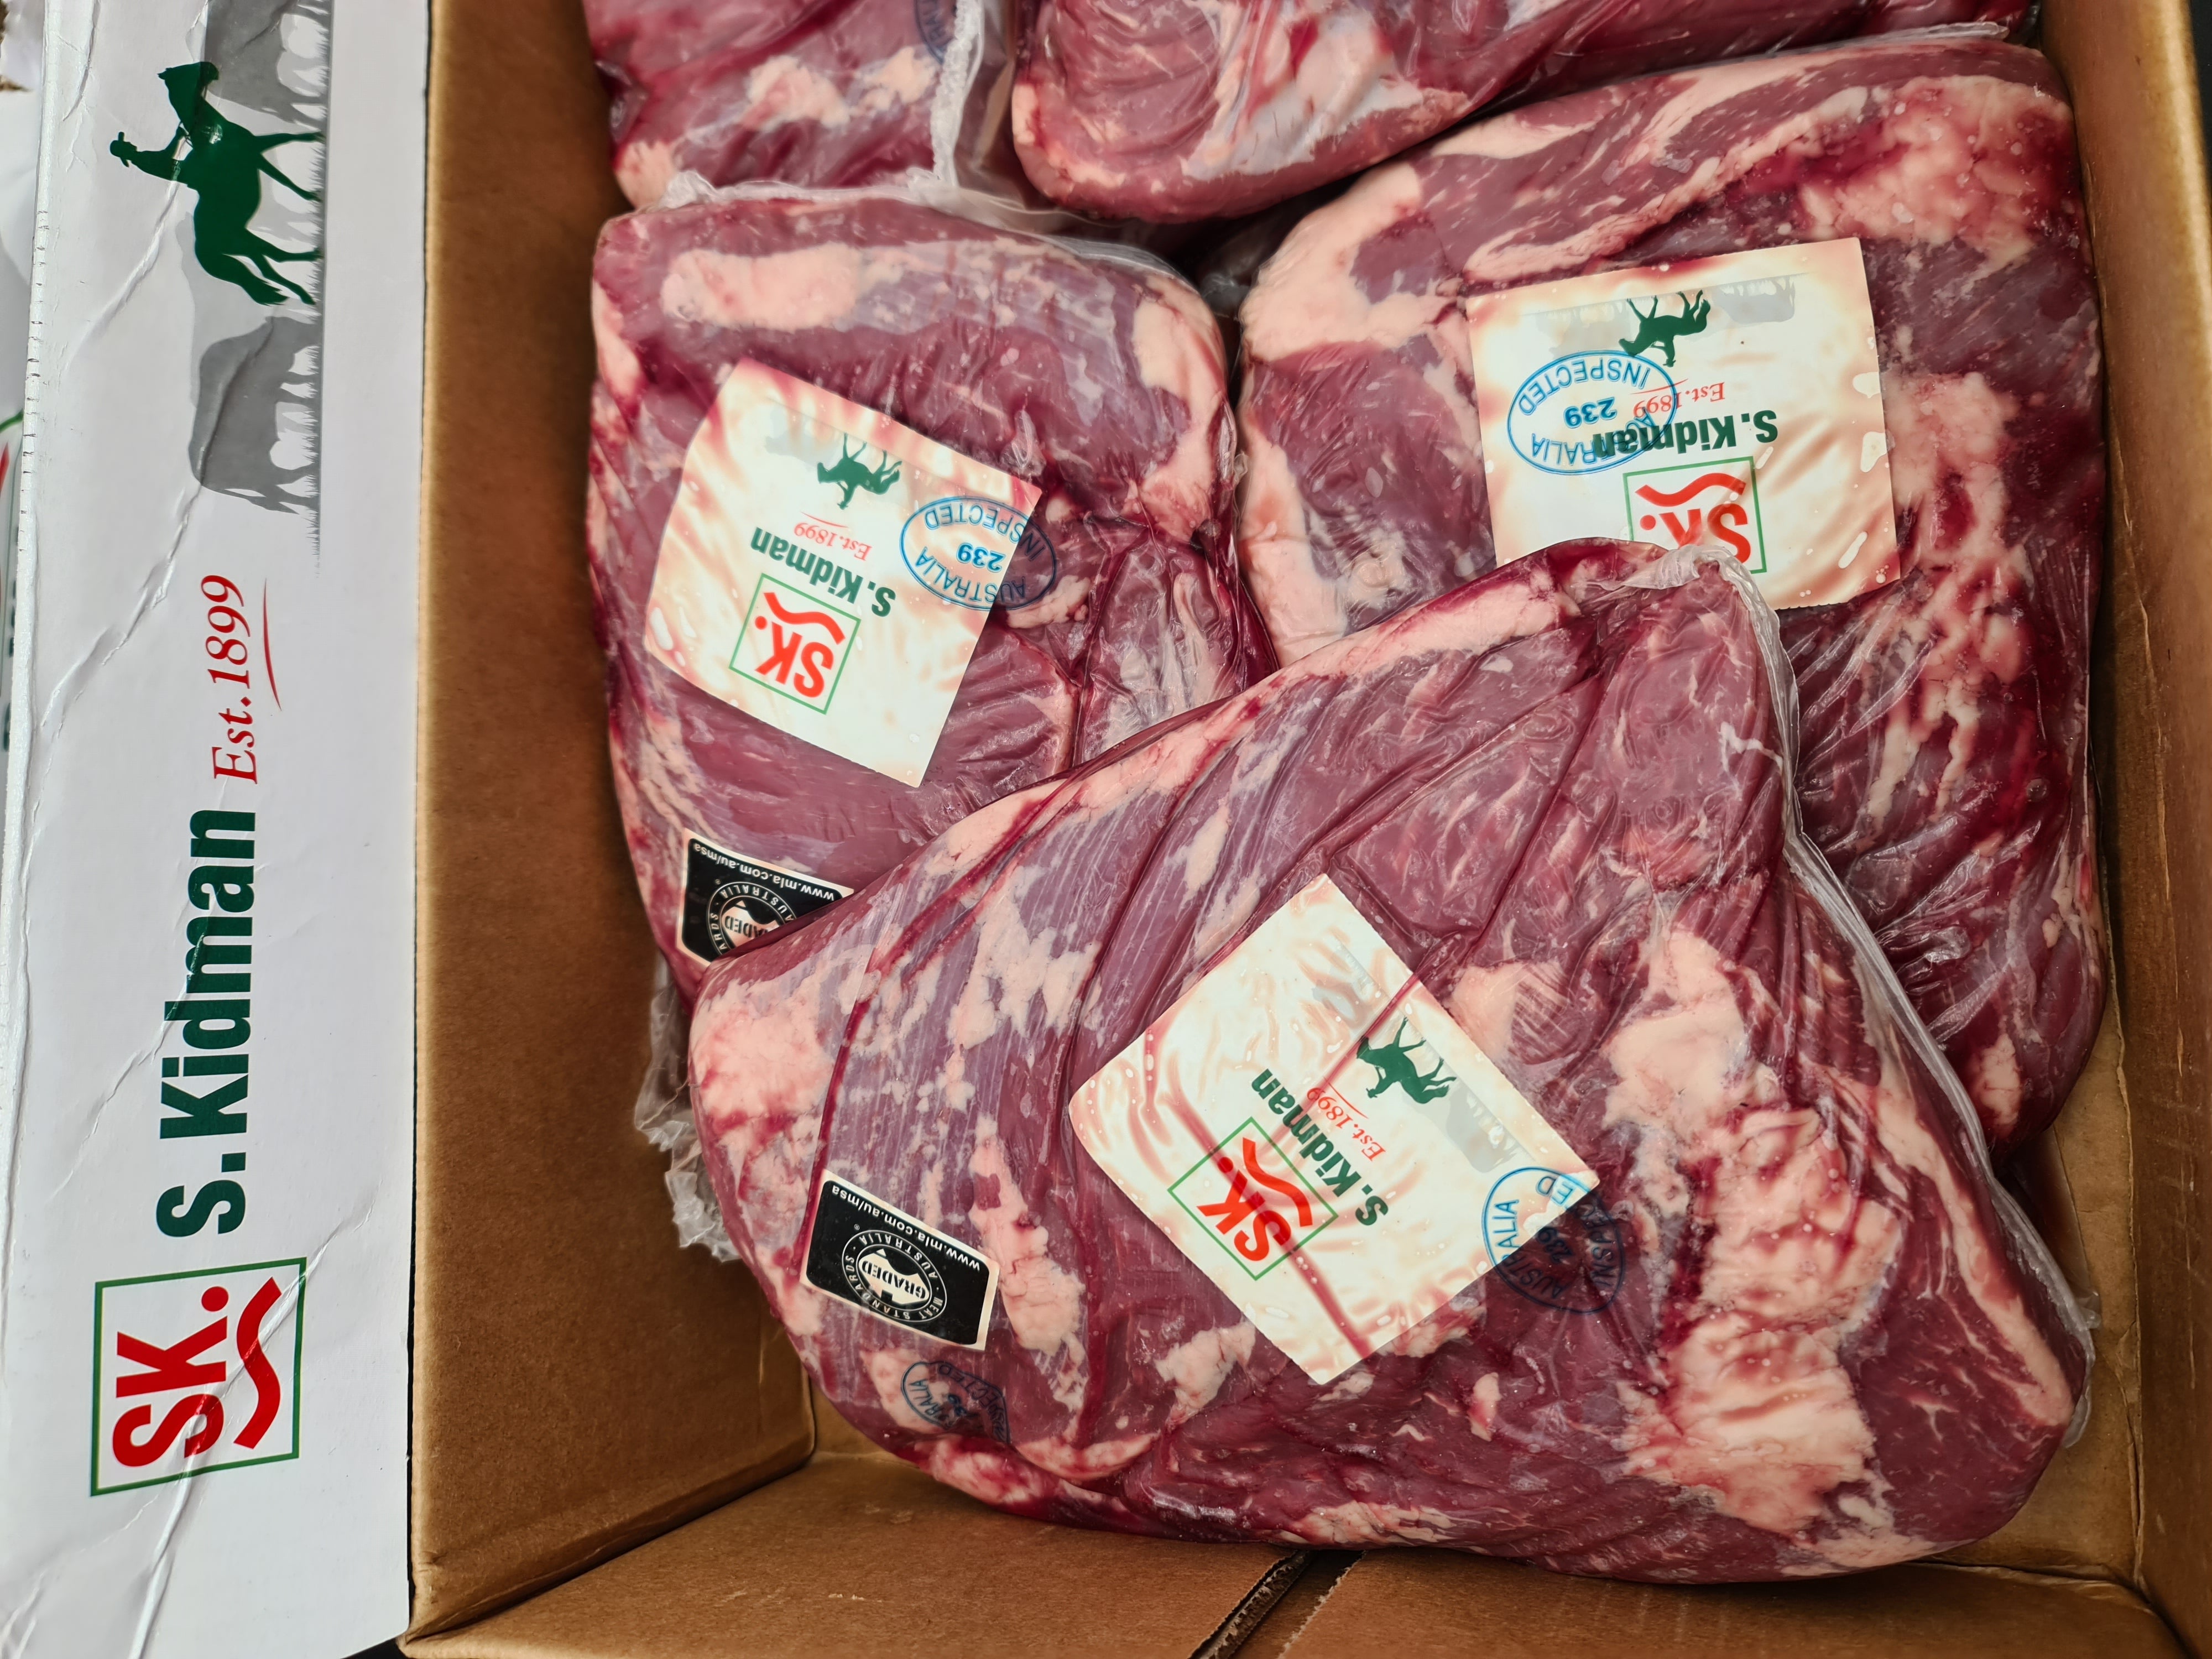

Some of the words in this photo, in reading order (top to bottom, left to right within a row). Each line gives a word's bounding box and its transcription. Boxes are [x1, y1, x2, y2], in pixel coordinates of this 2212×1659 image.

[1519, 357, 1650, 416] INSPECTED
[1563, 397, 1617, 429] 239
[1633, 382, 1725, 418] Est.1899
[1531, 406, 1656, 466] AUSTRALIA
[1593, 415, 1736, 459] Kidman
[1741, 410, 1778, 443] S.
[794, 521, 873, 561] Est.1899
[924, 503, 1045, 562] INSPECTED
[956, 542, 1006, 572] 239
[750, 527, 864, 603] Kidman
[914, 546, 1026, 603] AUSTRALIA
[867, 582, 897, 617] S.
[201, 575, 258, 785] Est.1899
[694, 843, 834, 901] www.mla.com.au/msa
[719, 885, 794, 922] AUSTRALIA
[725, 915, 769, 938] ADED
[160, 810, 256, 1139] Kidman
[1251, 1068, 1361, 1197] Kidman
[1306, 1087, 1386, 1161] Est.1899
[155, 1152, 247, 1238] S.
[1355, 1184, 1389, 1226] S.
[832, 1185, 980, 1271] www.mla.com.au/msa
[859, 1233, 938, 1279] AUSTRALIA
[1493, 1199, 1574, 1299] AUSTRALIA
[845, 1255, 911, 1320] STANDARDS
[862, 1260, 926, 1300] GRADED
[918, 1296, 943, 1319] MEAT
